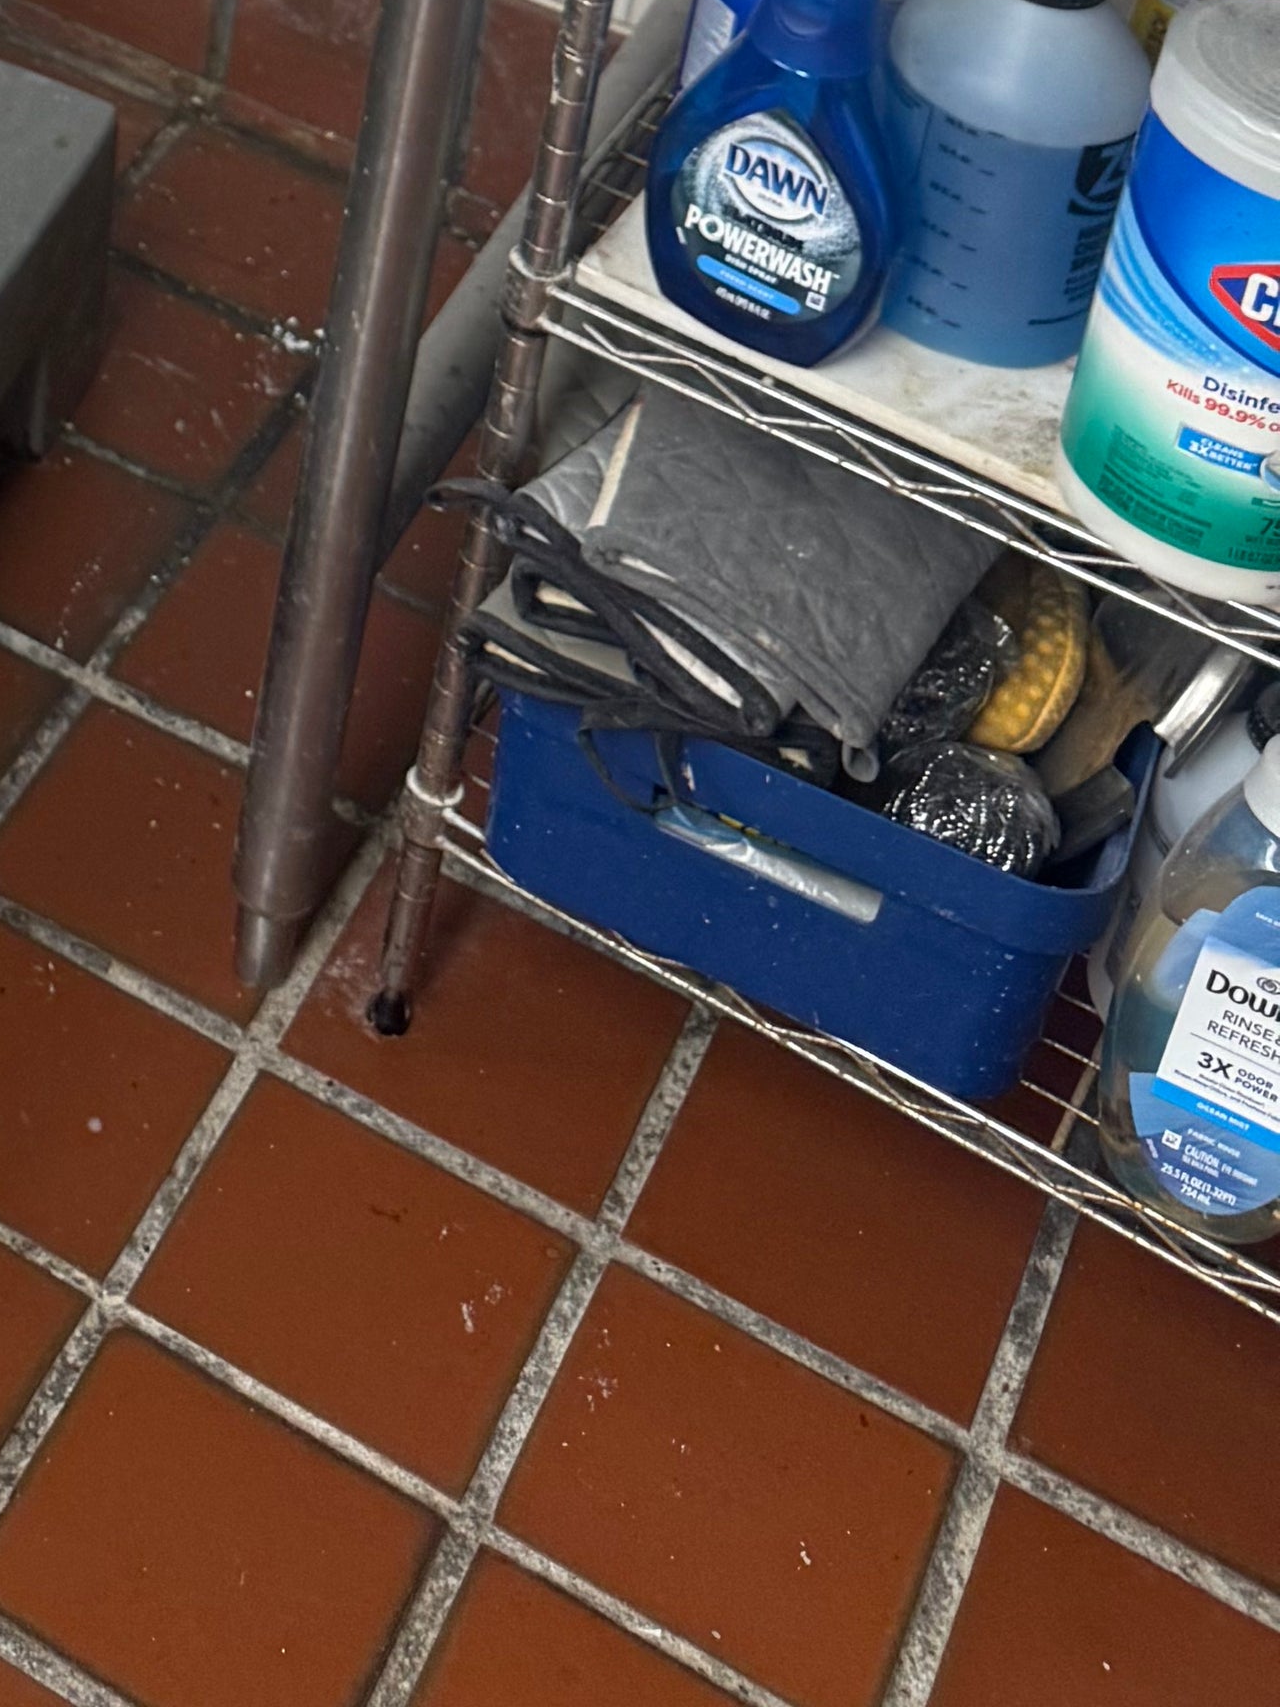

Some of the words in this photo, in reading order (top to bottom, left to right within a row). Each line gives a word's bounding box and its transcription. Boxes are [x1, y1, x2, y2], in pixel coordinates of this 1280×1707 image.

[724, 142, 828, 216] DAWN
[684, 203, 832, 295] POWERWASH
[1167, 379, 1201, 405] Kills
[1204, 397, 1266, 429] 99.9%
[1200, 437, 1245, 459] CLEANS
[1206, 969, 1280, 1023] Dow
[1207, 1019, 1280, 1064] REFRESH
[1222, 1009, 1275, 1042] RINSE
[1197, 1051, 1233, 1080] 3X
[1238, 1068, 1274, 1089] ODOR
[1234, 1076, 1279, 1102] POWER
